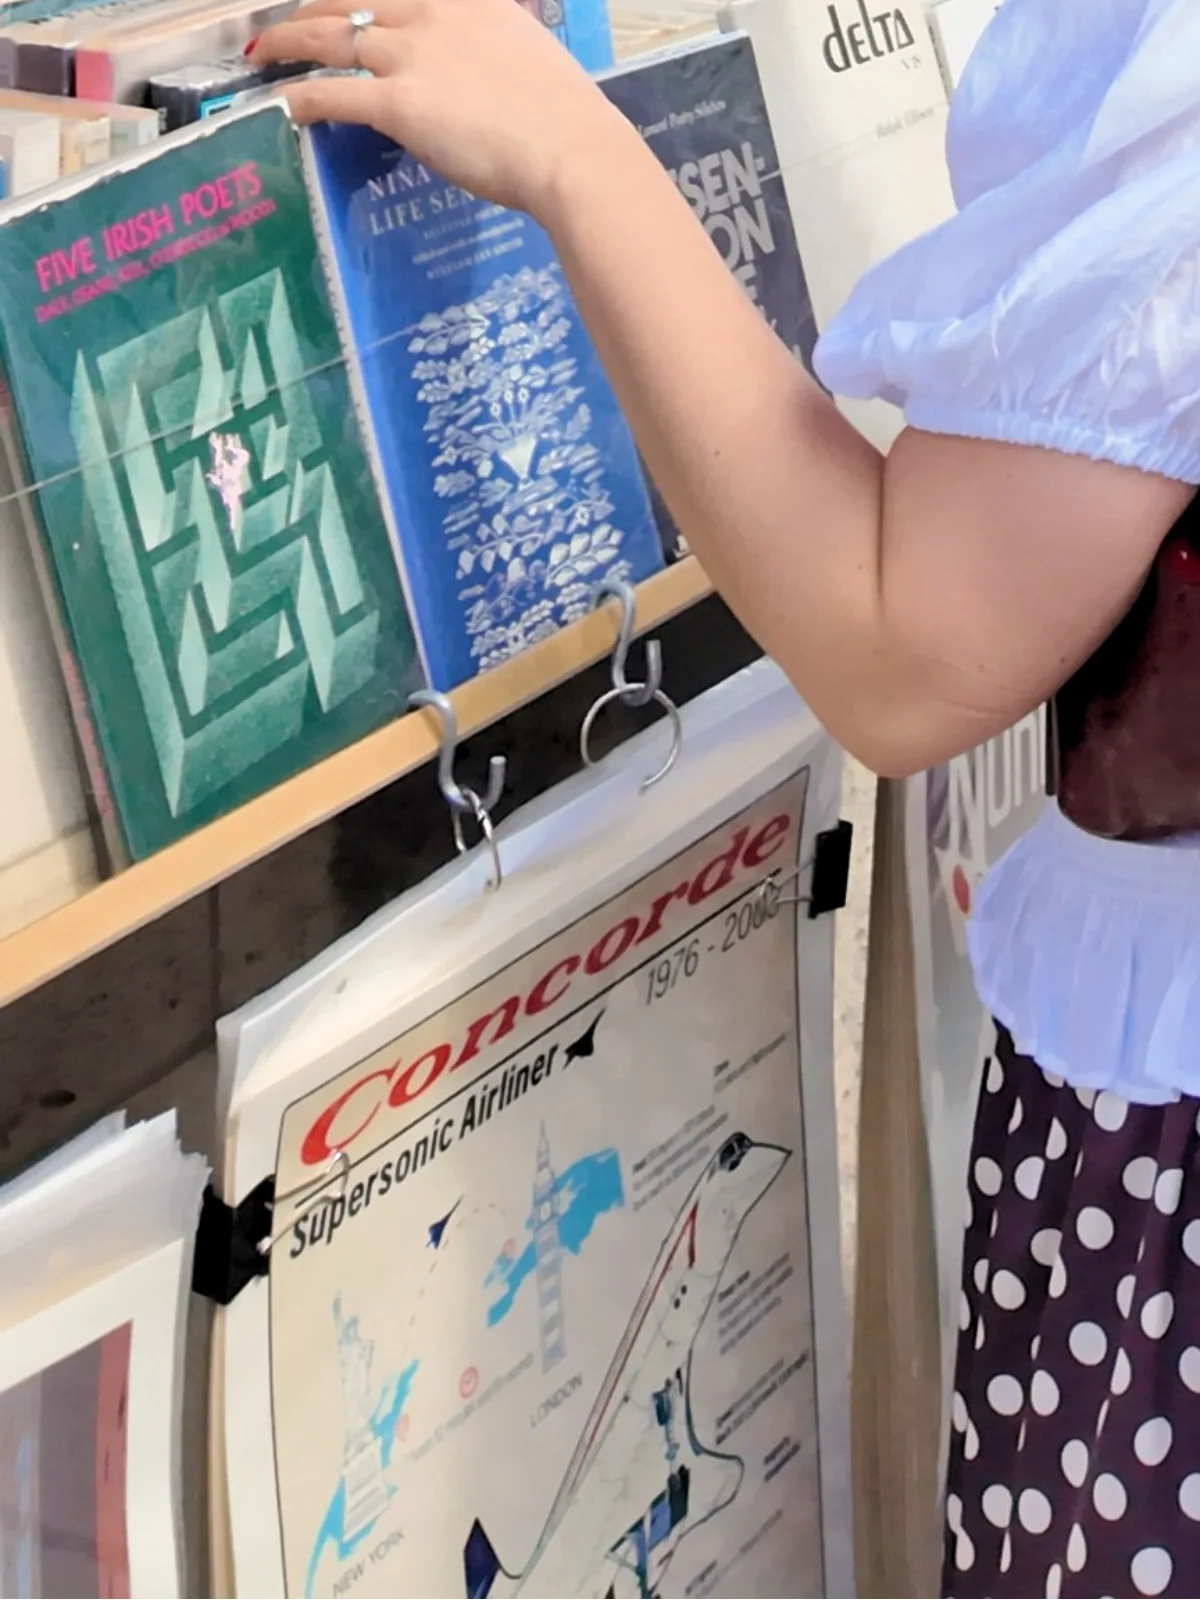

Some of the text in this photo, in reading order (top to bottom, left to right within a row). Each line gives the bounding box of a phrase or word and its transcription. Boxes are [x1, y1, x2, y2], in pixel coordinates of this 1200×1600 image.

[367, 163, 432, 201] NINA
[668, 141, 766, 219] SEN-
[36, 160, 263, 293] FIVE IRISH POETS
[369, 197, 425, 237] LIFE
[300, 813, 791, 1166] Concorde
[645, 937, 700, 1006] 1976
[289, 1041, 559, 1259] Supersonic Airliner
[531, 1372, 583, 1428] LONDON
[332, 1560, 366, 1599] NEW
